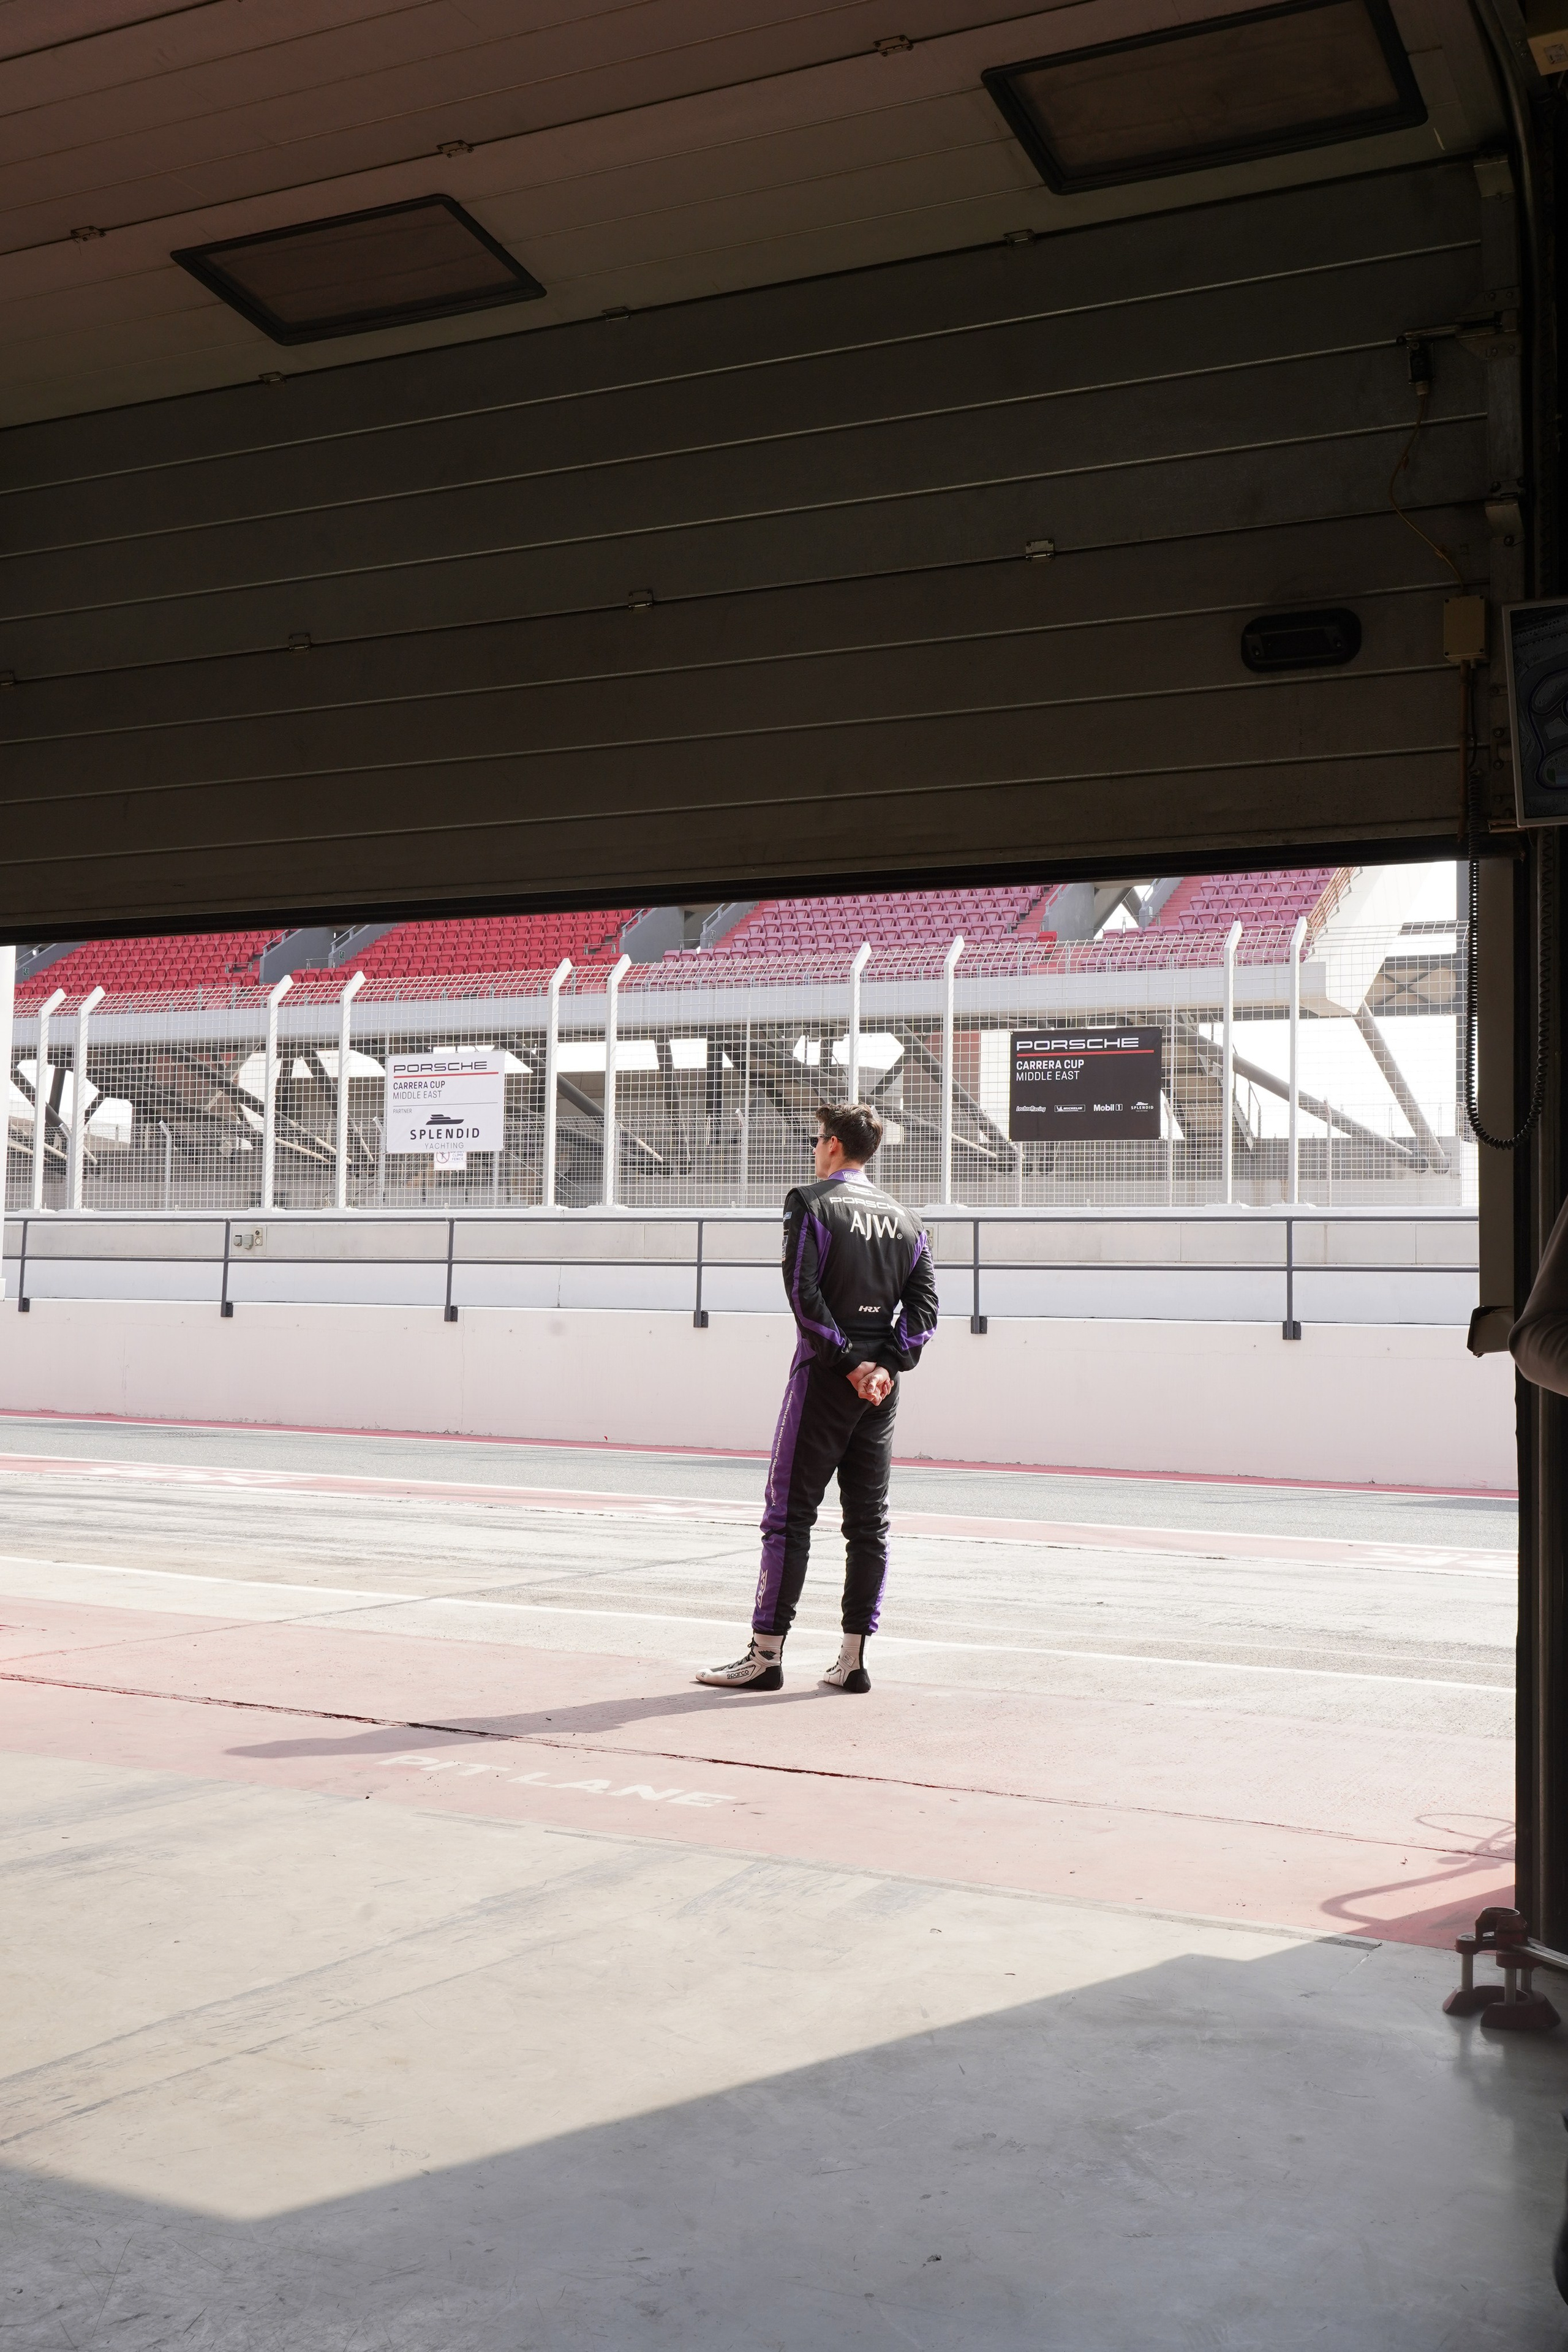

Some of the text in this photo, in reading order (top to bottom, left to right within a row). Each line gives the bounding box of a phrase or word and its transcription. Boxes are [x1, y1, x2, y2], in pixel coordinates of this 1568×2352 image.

[1016, 1037, 1139, 1051] PORSCHE
[393, 1061, 488, 1073] PORSCHE
[1016, 1059, 1085, 1070] CARRERA CUP
[1016, 1070, 1080, 1081] MIDDLE EAST
[393, 1080, 446, 1090] CARRERA CUP
[393, 1090, 442, 1100] MIDDLE EAST
[410, 1128, 480, 1140] SPLENDID
[424, 1141, 465, 1150] YACHTING
[774, 1426, 784, 1458] AVIATION
[782, 1389, 794, 1427] EFFICIENCY
[726, 1670, 749, 1679] sparco
[374, 1754, 738, 1808] PIT LANE
